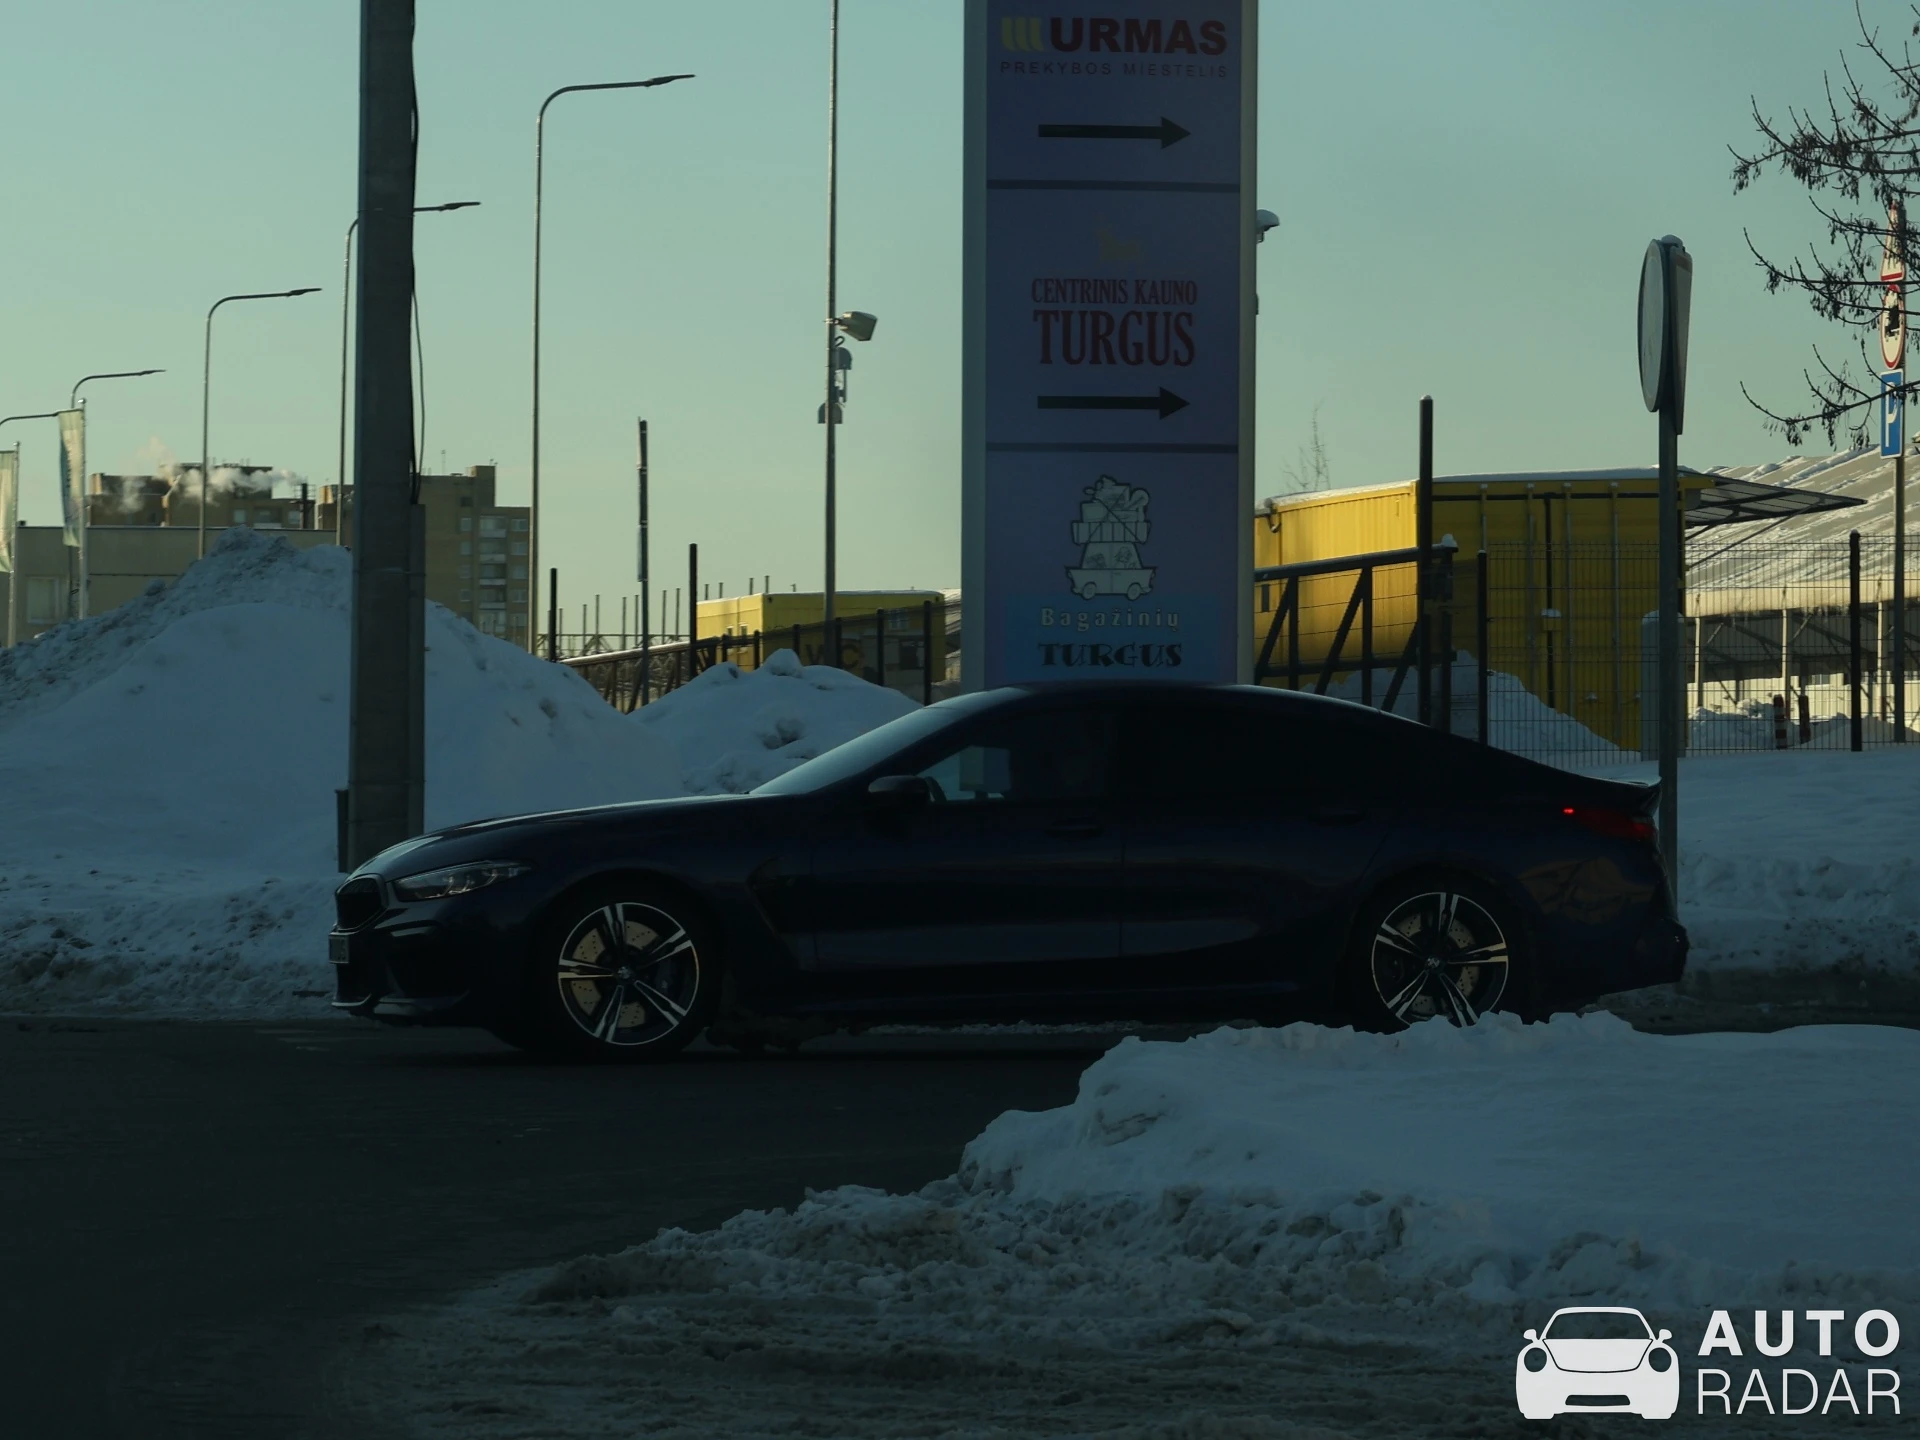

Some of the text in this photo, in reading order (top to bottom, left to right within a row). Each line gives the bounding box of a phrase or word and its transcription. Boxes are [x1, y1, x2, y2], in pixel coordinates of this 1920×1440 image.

[1051, 17, 1227, 55] URMAS
[1000, 61, 1227, 78] PREKYBOS MIESTELIS
[1032, 278, 1198, 305] CENTRINIS KAUNO
[1034, 310, 1195, 367] TURGUS
[1885, 383, 1898, 447] P
[1041, 607, 1180, 632] Bagažinių
[1039, 643, 1181, 667] TURGUS
